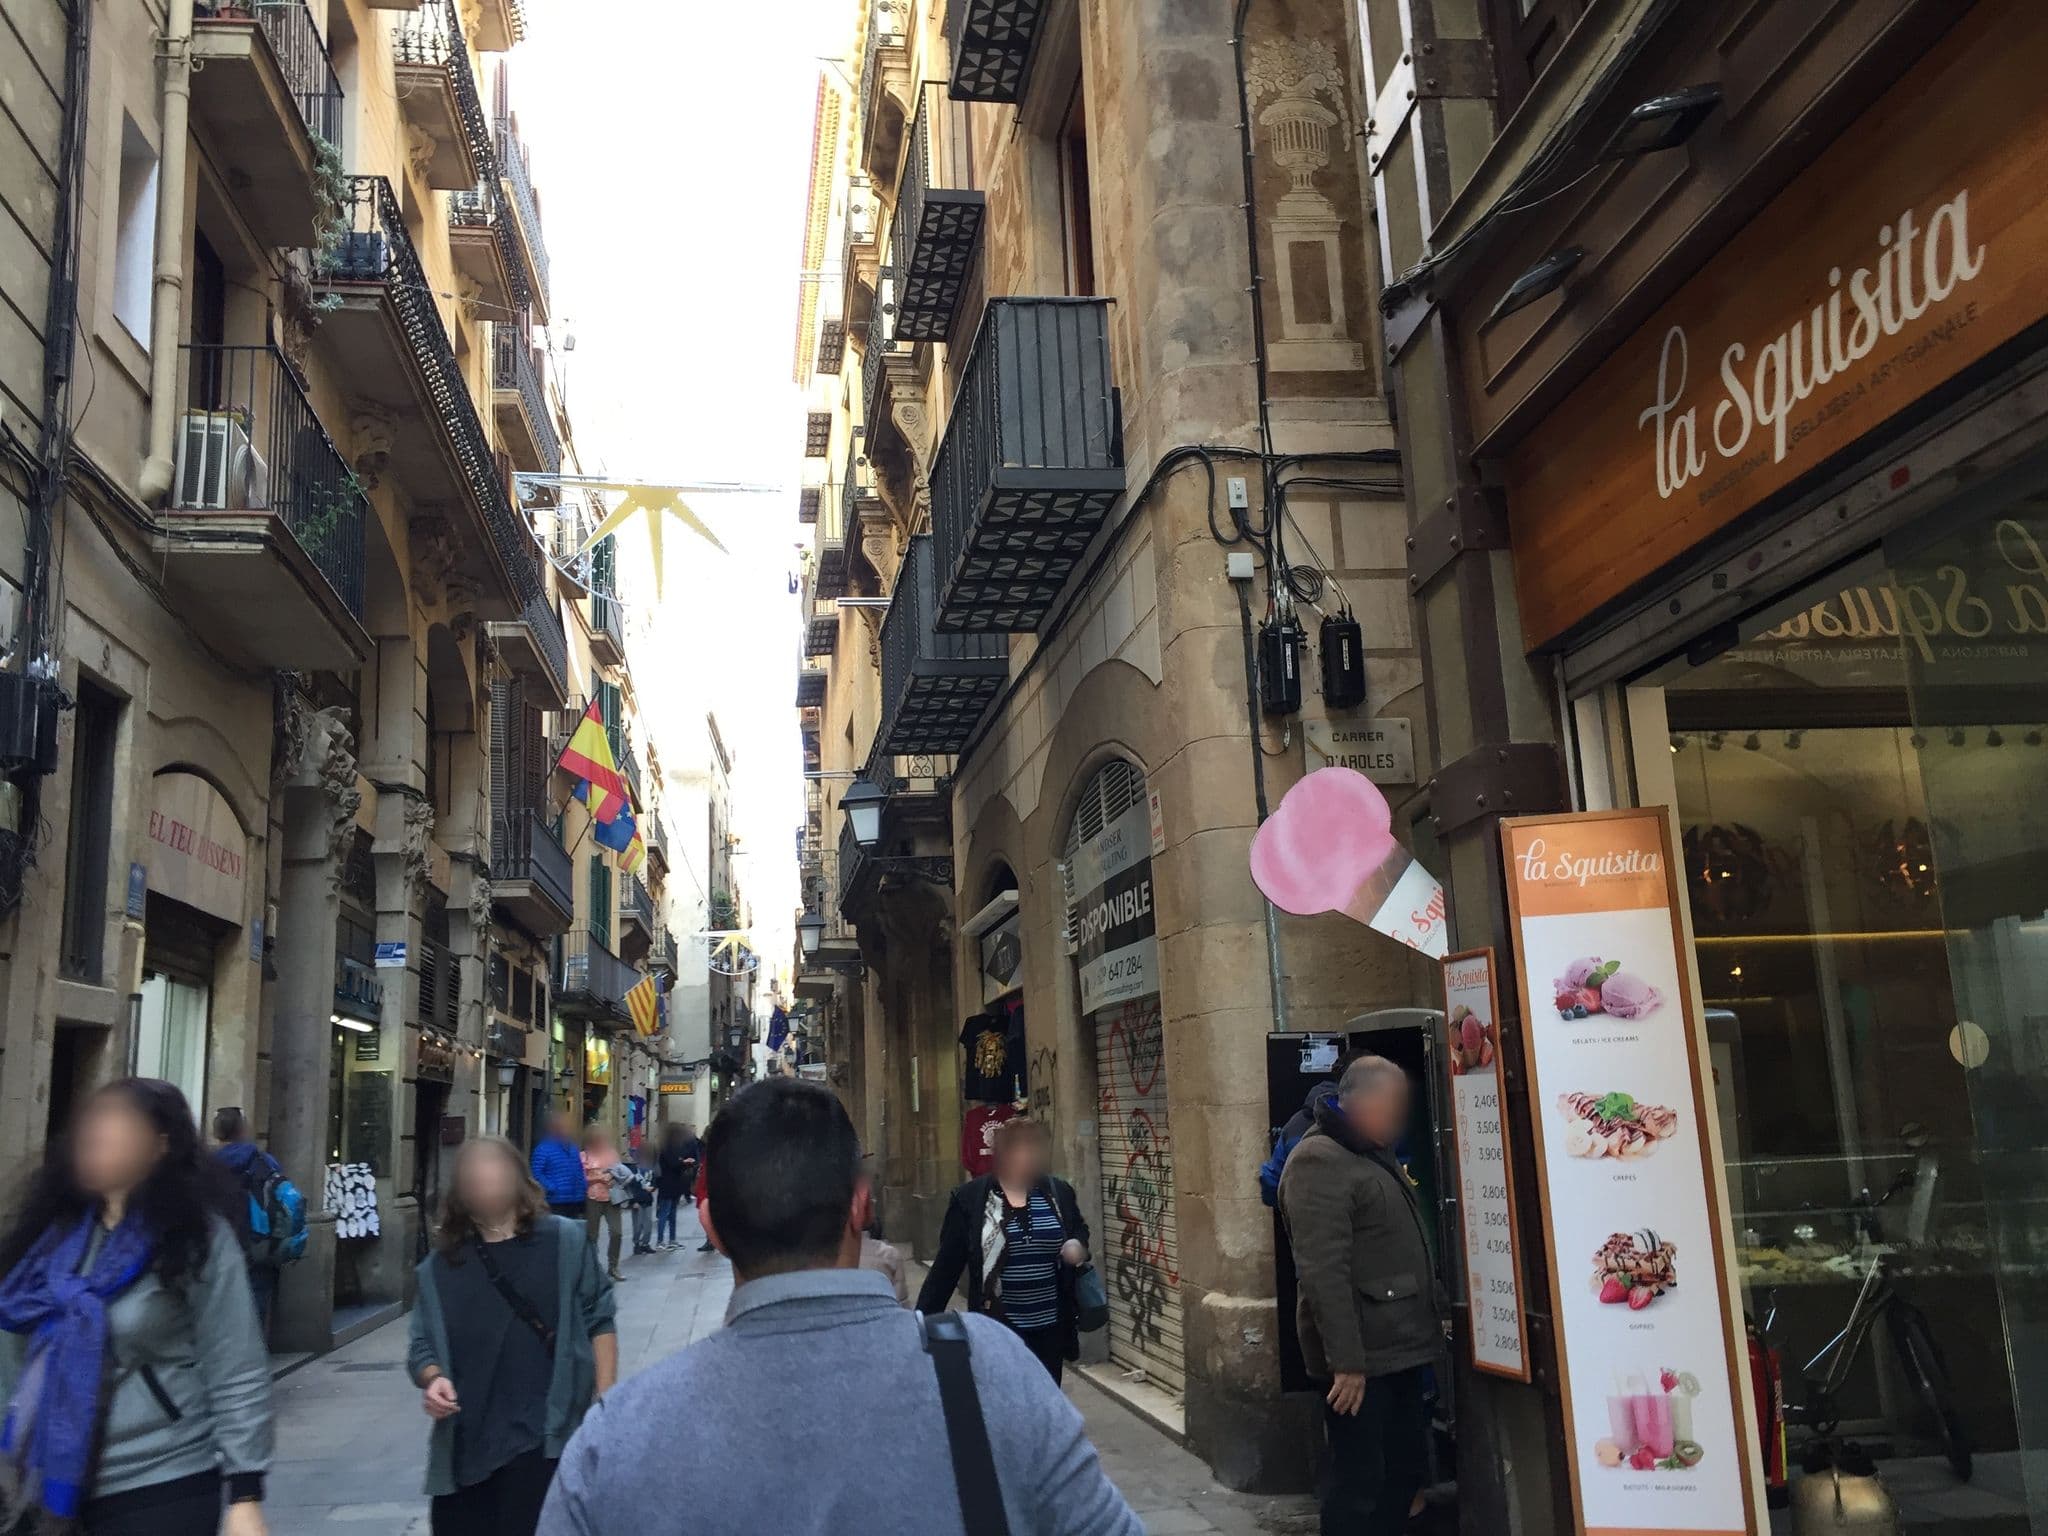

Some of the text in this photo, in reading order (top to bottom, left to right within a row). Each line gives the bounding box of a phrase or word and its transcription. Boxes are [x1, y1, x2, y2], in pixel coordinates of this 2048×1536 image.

[1639, 189, 1986, 499] la Squisita
[1332, 731, 1384, 742] CARRER
[1326, 753, 1394, 769] D'AROLES
[149, 808, 166, 843] EL
[1516, 839, 1661, 887] la Squisita
[1080, 880, 1151, 946] DISPONIBLE
[1108, 959, 1124, 982] 647
[1126, 954, 1143, 976] 284
[1474, 1094, 1498, 1109] 2,40€
[1476, 1121, 1500, 1135] 3,50€
[1482, 1185, 1507, 1200] 2,80€
[1484, 1212, 1509, 1226] 3,90€
[1486, 1240, 1512, 1254] 4,30€
[1490, 1279, 1515, 1296] 3,50€
